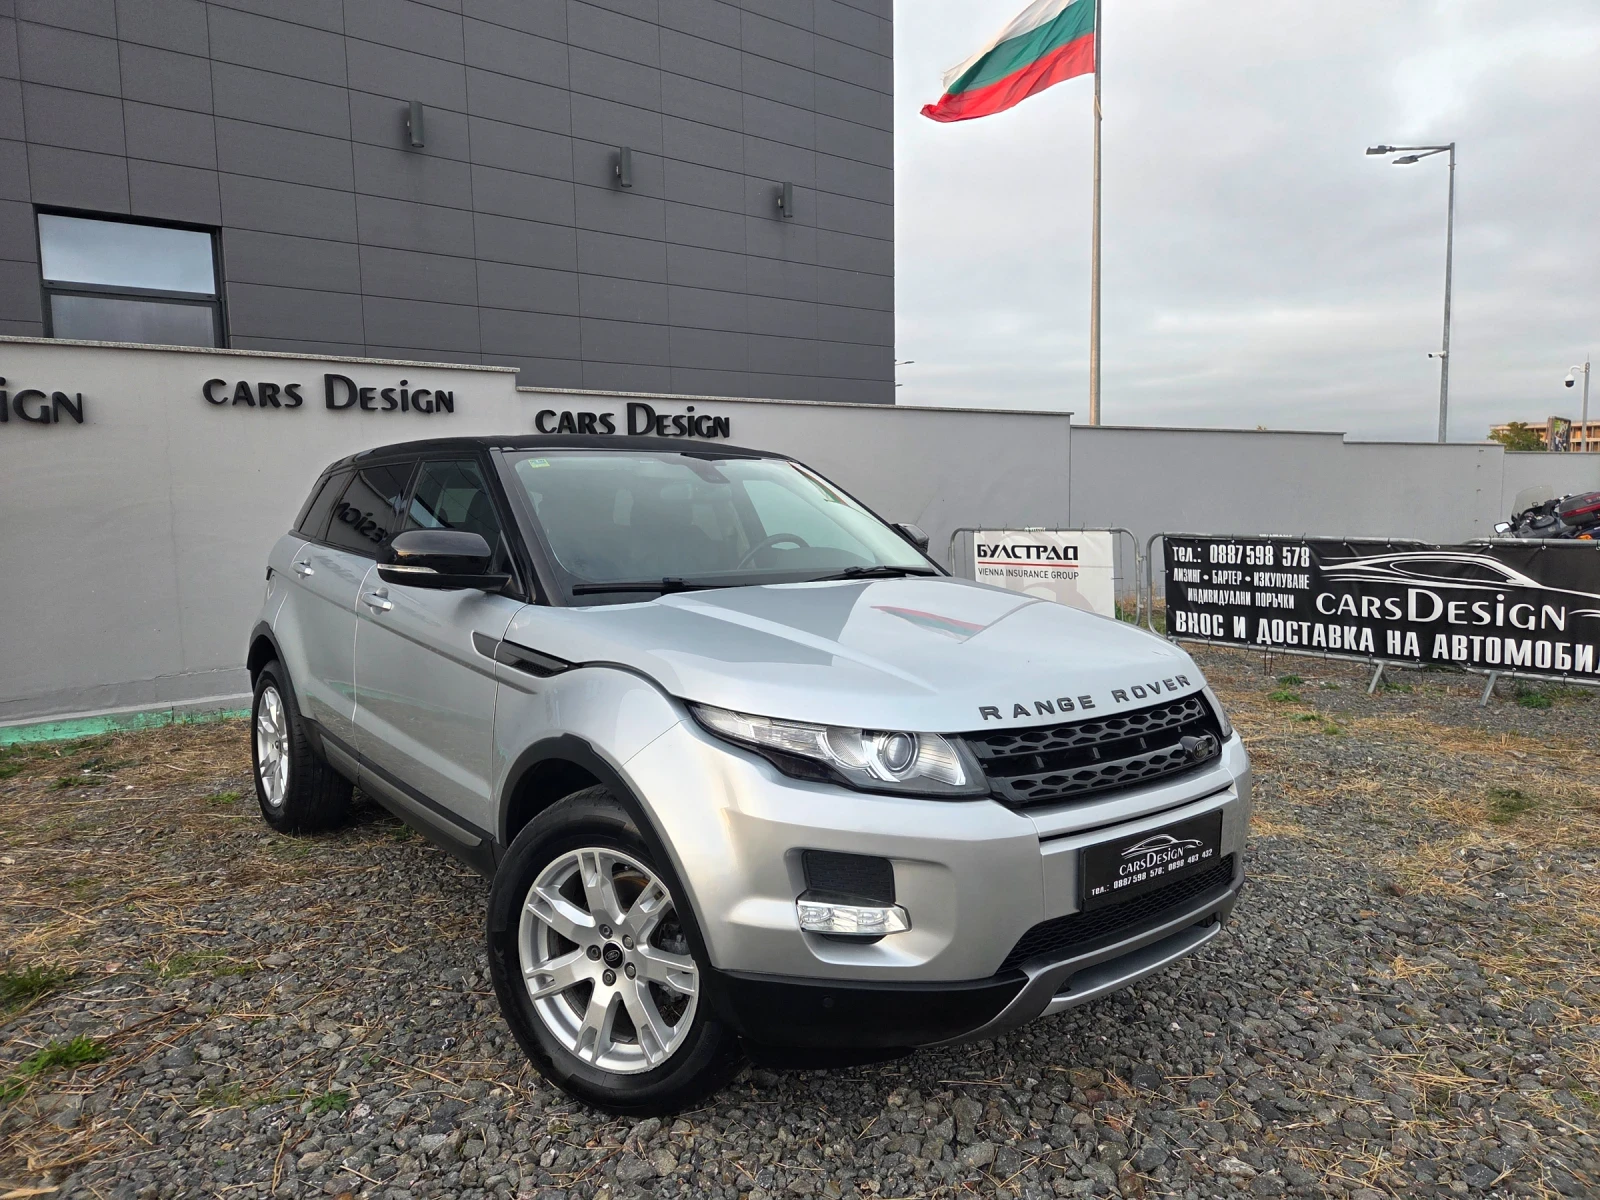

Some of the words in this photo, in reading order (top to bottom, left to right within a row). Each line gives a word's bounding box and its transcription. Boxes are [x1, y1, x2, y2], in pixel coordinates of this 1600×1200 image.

[202, 378, 303, 408] CARS
[535, 409, 616, 434] CARS
[977, 544, 1078, 560] БУЛСТРАД
[1172, 546, 1201, 563] тел.:
[1209, 544, 1243, 564] 0887
[1246, 545, 1274, 566] 598
[1282, 547, 1310, 567] 578
[978, 567, 1004, 576] VIENNA
[1005, 569, 1049, 579] INSURANCE
[1051, 570, 1079, 580] GROUP
[1173, 568, 1201, 583] ЛИЗИНГ
[1212, 570, 1242, 585] БАРТЕР
[1253, 572, 1309, 589] ИЗКУПУВАНЕ
[1187, 588, 1251, 606] ИНДИВИДУАЛНИ
[1255, 592, 1294, 609] ПОРЪЧКИ
[1175, 611, 1224, 637] ВНОС
[1233, 616, 1246, 639] И
[1256, 618, 1375, 652] ДОСТАВКА
[1386, 630, 1420, 657] НА
[978, 695, 1096, 720] RANGE
[1111, 674, 1191, 703] ROVER
[1113, 877, 1132, 889] 0887
[1132, 872, 1147, 883] 598
[1201, 848, 1213, 858] 432
